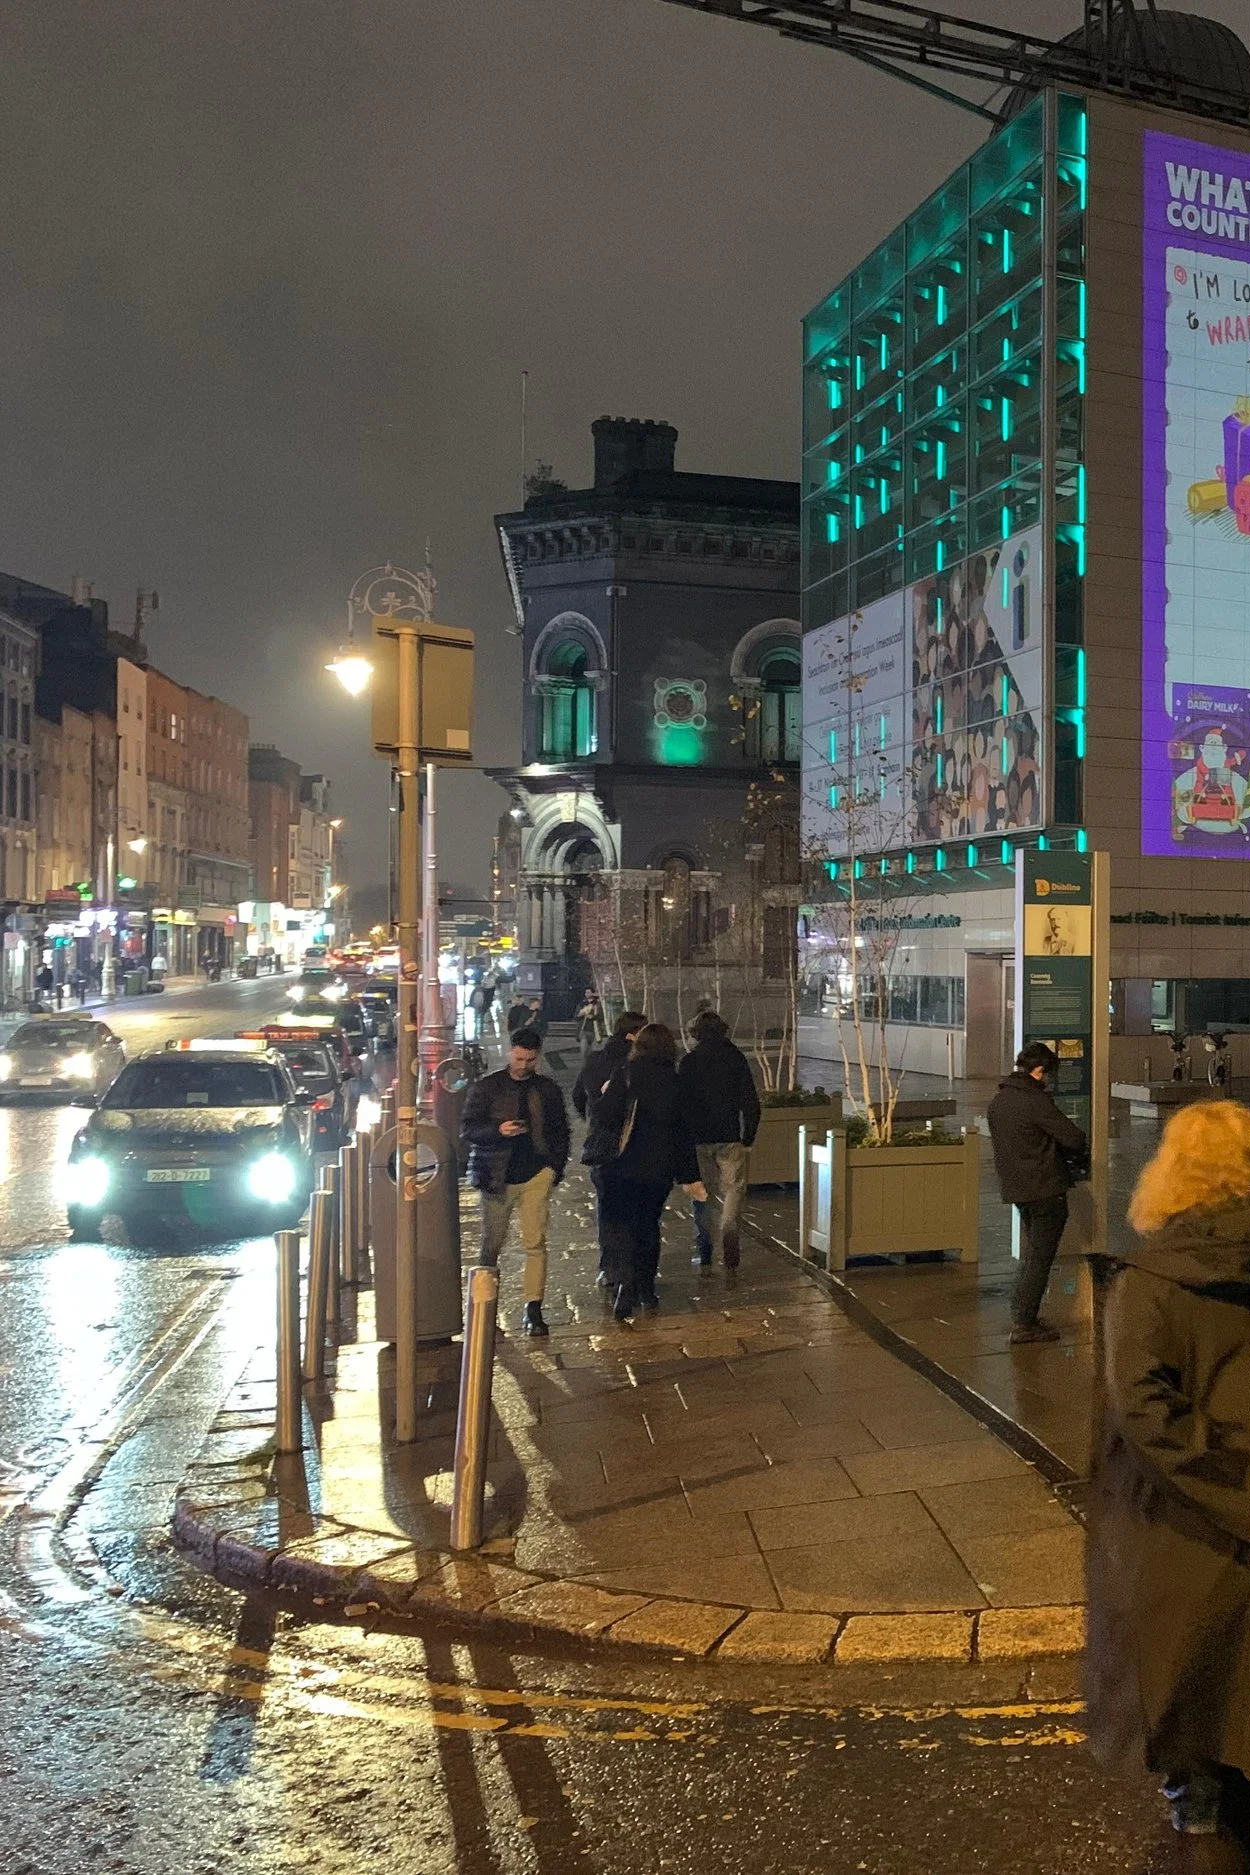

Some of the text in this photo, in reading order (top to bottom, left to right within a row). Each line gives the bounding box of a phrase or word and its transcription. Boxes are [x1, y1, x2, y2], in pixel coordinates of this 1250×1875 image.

[1193, 272, 1220, 299] I'M
[1186, 309, 1200, 330] to
[1187, 700, 1236, 714] DAIRY MILK
